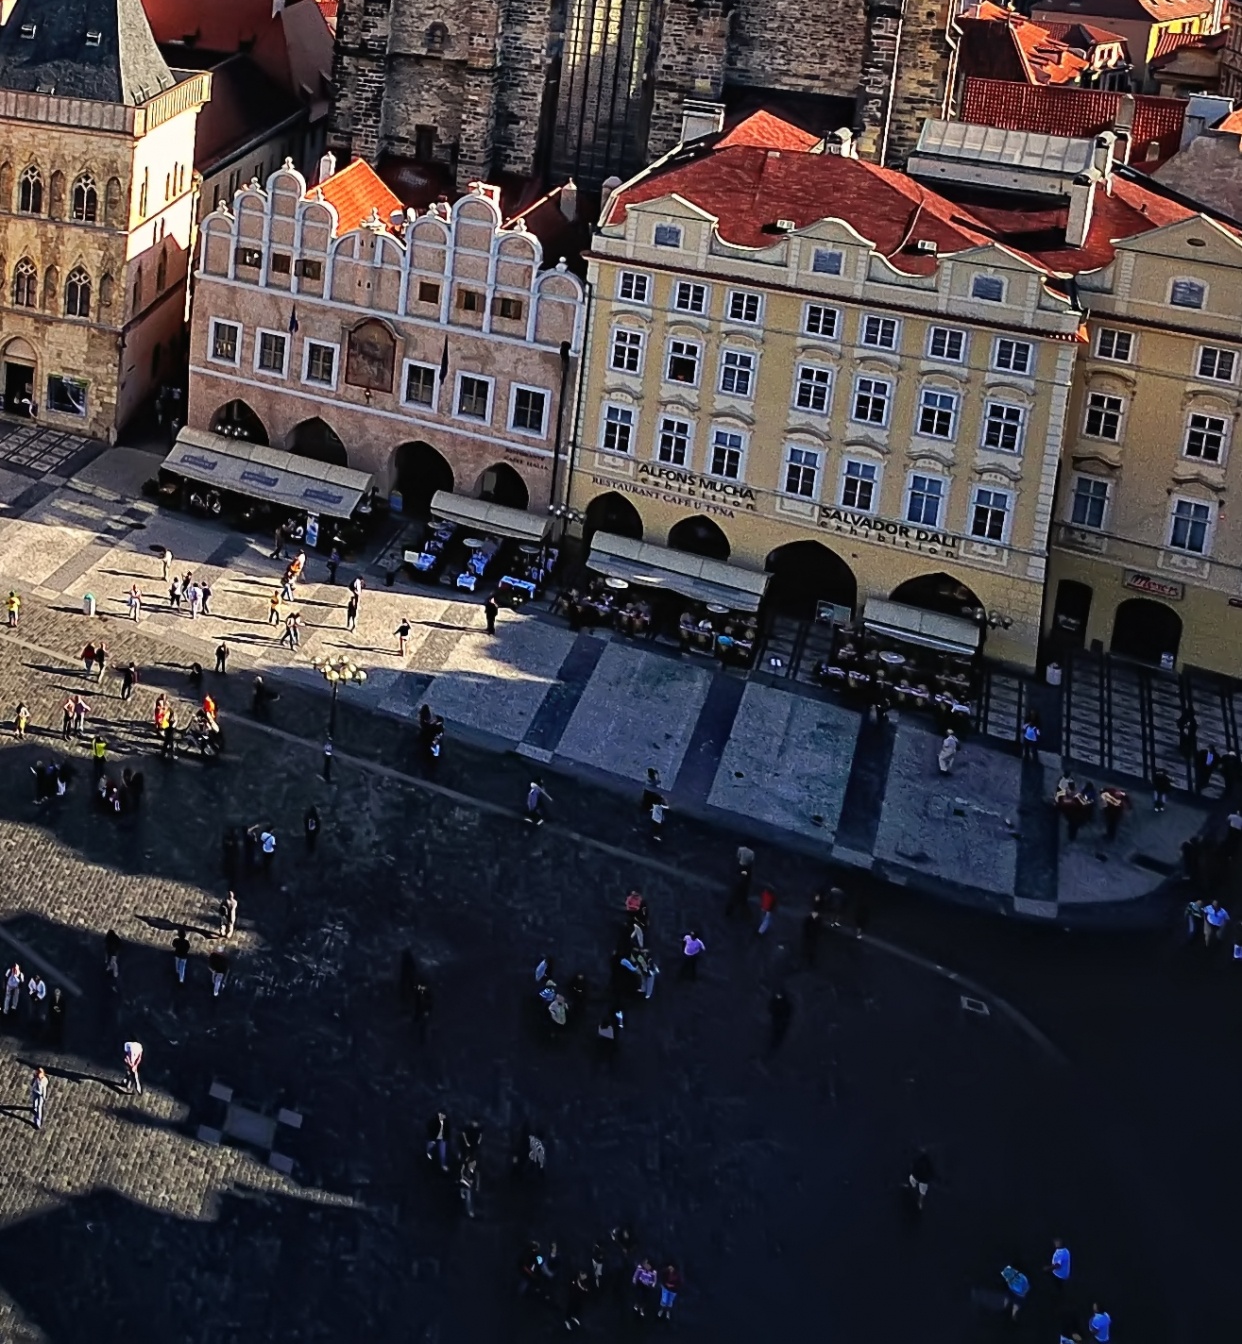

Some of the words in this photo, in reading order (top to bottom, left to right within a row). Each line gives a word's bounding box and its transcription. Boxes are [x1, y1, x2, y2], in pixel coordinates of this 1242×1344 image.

[592, 477, 659, 499] RESTAURANT
[639, 464, 696, 485] ALFONS
[699, 478, 755, 500] MUCHA
[641, 478, 755, 510] exhibition
[821, 507, 910, 538] SALVADOR
[916, 529, 956, 548] DALI
[821, 520, 956, 558] exhibition
